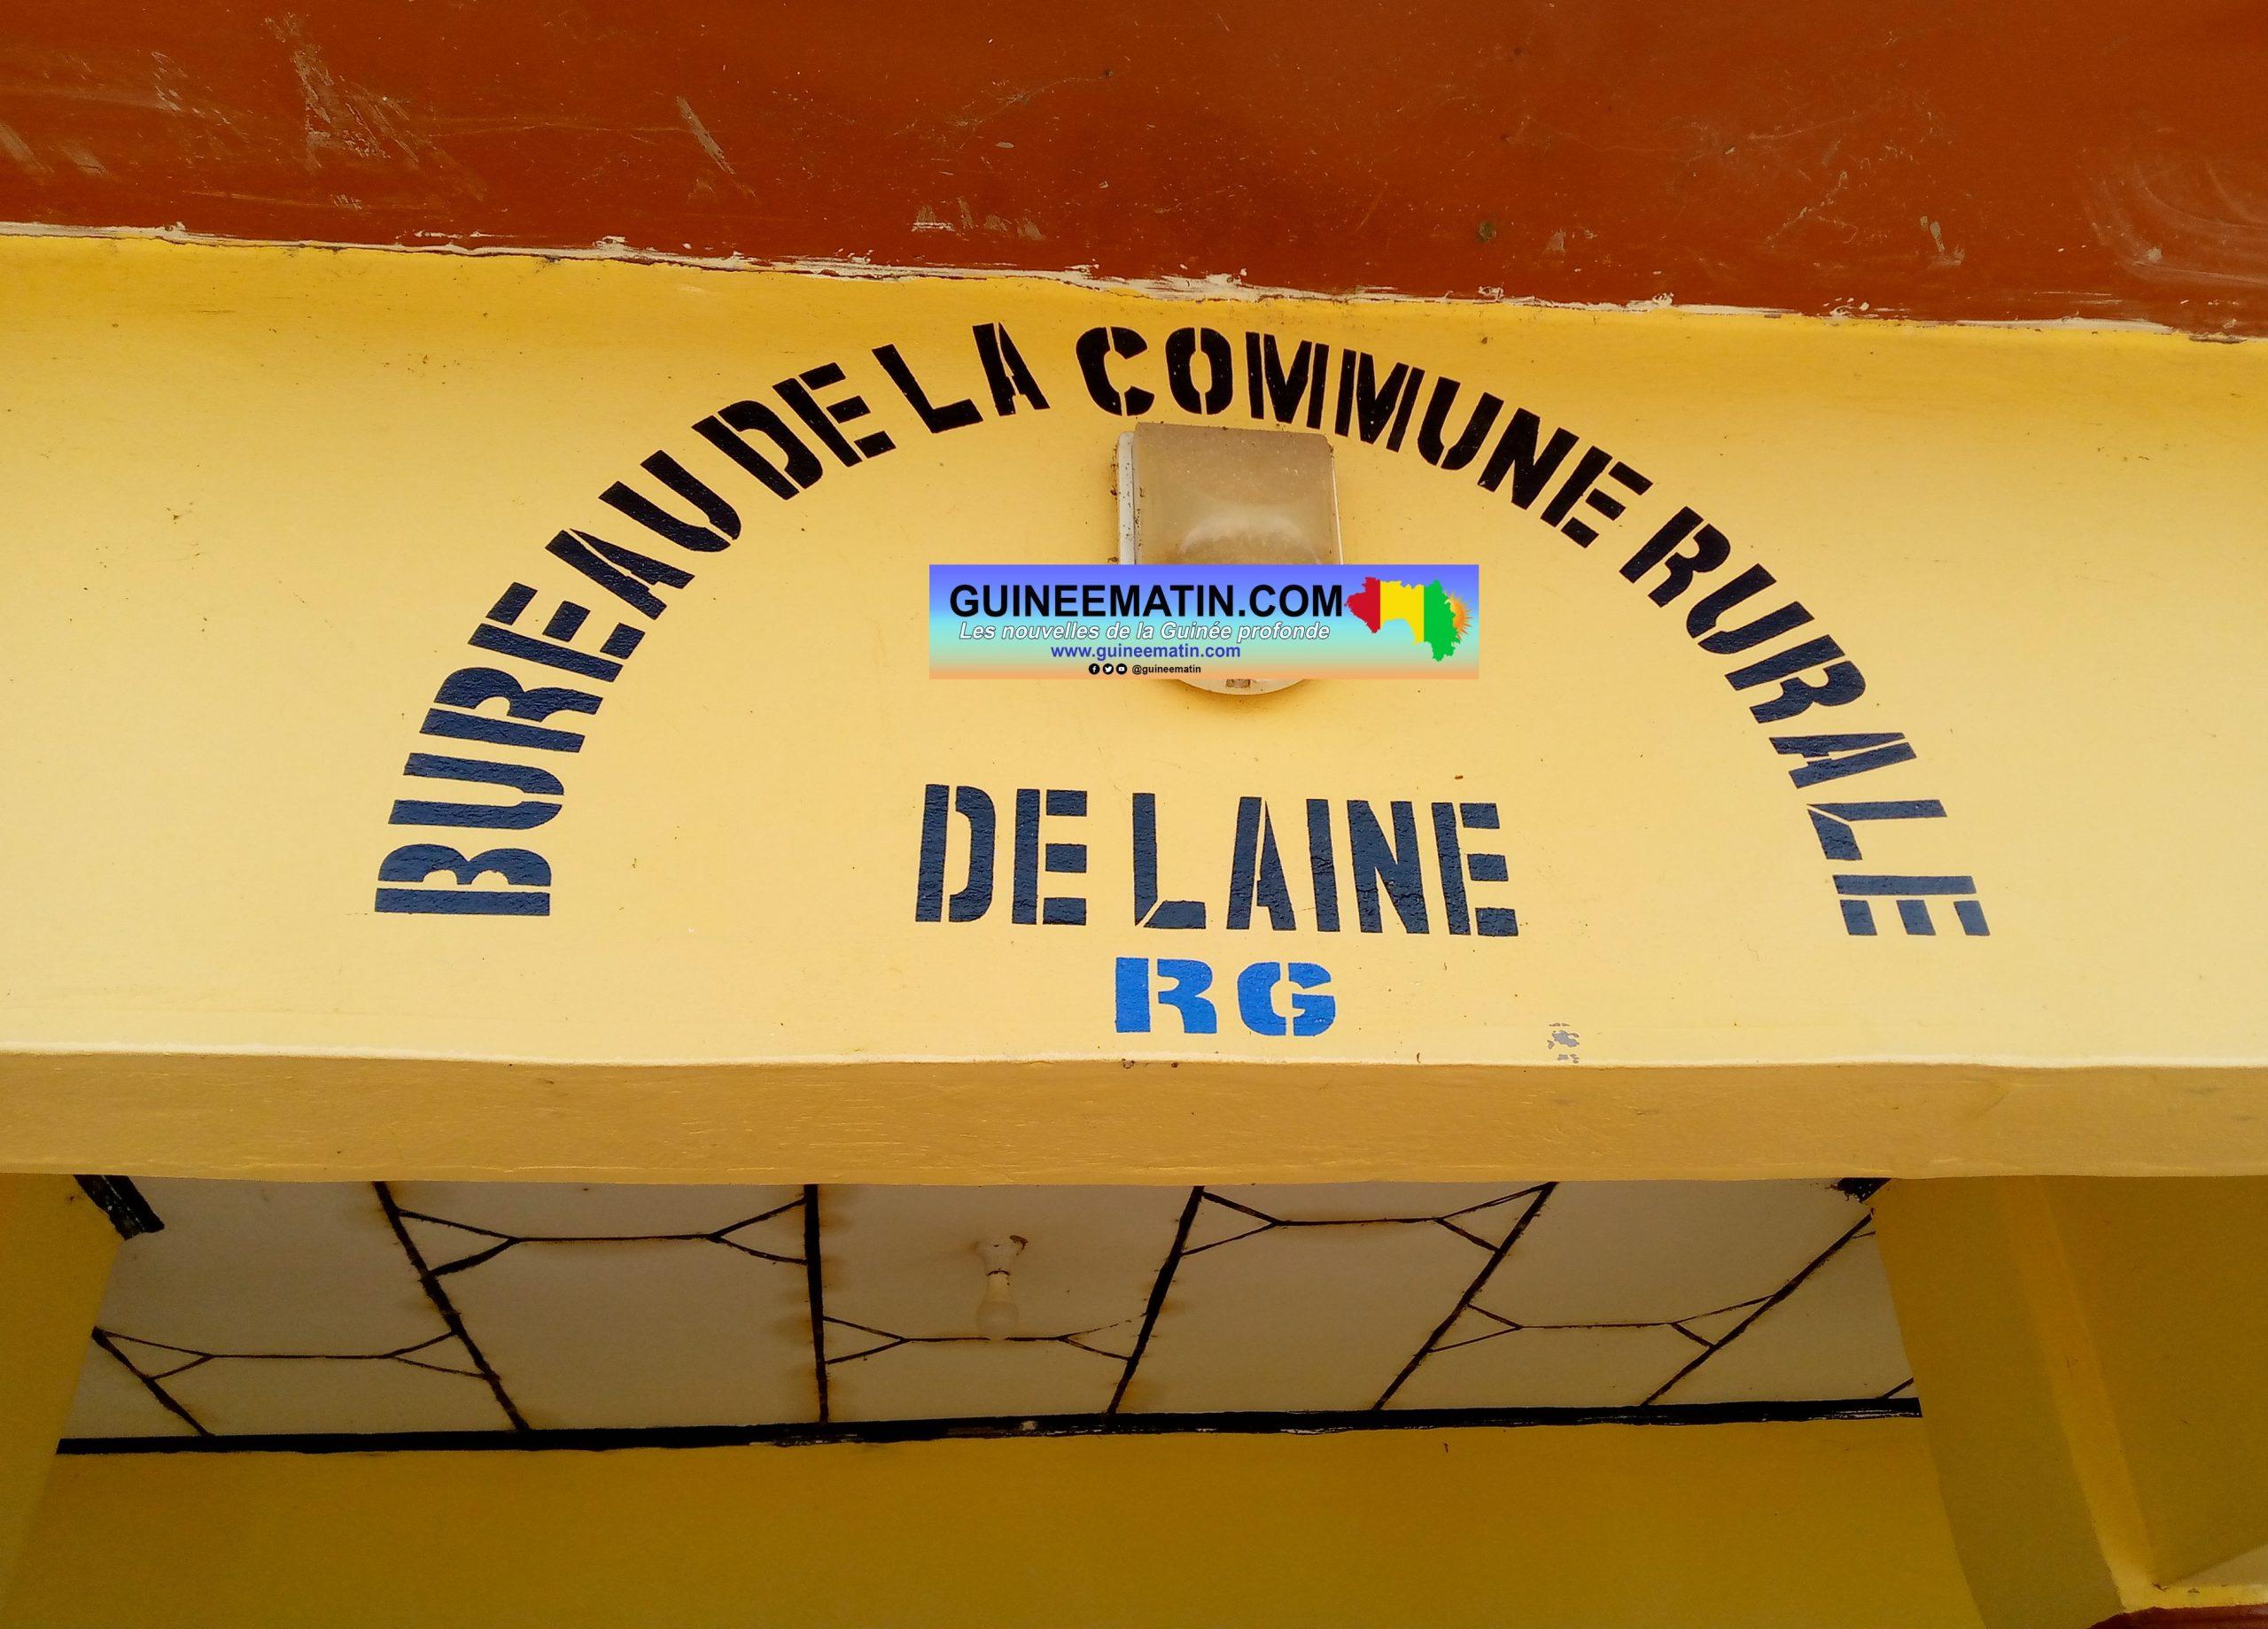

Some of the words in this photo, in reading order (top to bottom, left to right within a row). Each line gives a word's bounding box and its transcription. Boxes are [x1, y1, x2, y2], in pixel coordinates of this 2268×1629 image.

[374, 449, 742, 917] BUREAU
[691, 361, 897, 500] DE
[871, 322, 1051, 434] LA
[1076, 326, 1653, 548] COMMUNE
[1619, 506, 1988, 936] RURALE
[915, 783, 1088, 927] DE
[1131, 792, 1518, 937] LAINE
[1115, 957, 1337, 1036] RG
